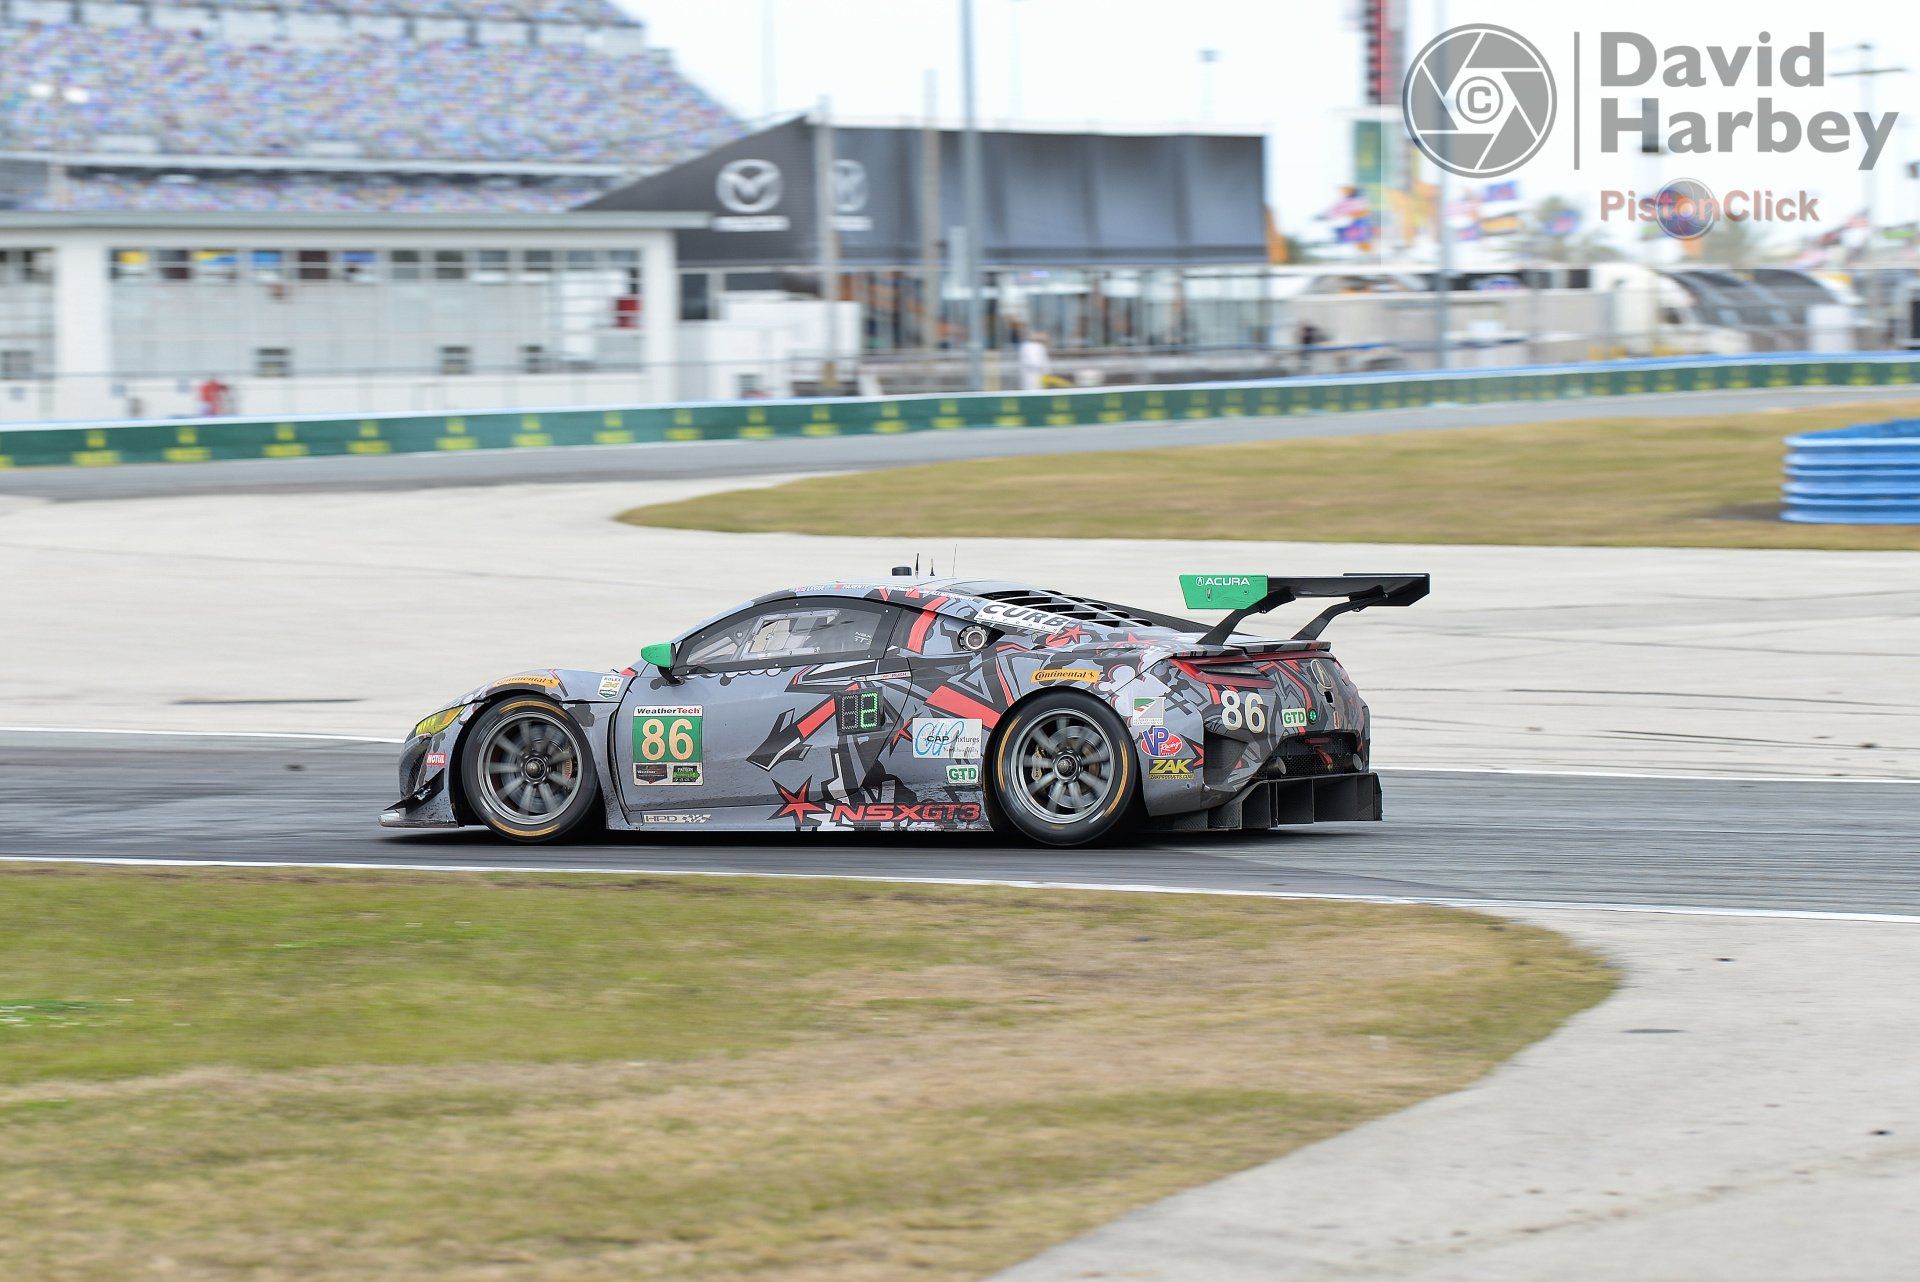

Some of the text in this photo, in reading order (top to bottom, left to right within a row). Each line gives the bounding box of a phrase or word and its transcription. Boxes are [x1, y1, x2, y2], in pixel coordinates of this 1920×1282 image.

[1205, 577, 1250, 586] ACURA
[982, 604, 1070, 626] CURB
[1035, 671, 1086, 680] Continental
[1220, 690, 1265, 733] 86
[1283, 711, 1305, 723] GTD
[642, 718, 694, 760] 86
[1142, 727, 1169, 756] VP
[948, 768, 977, 780] GTD
[1149, 759, 1193, 774] ZAK
